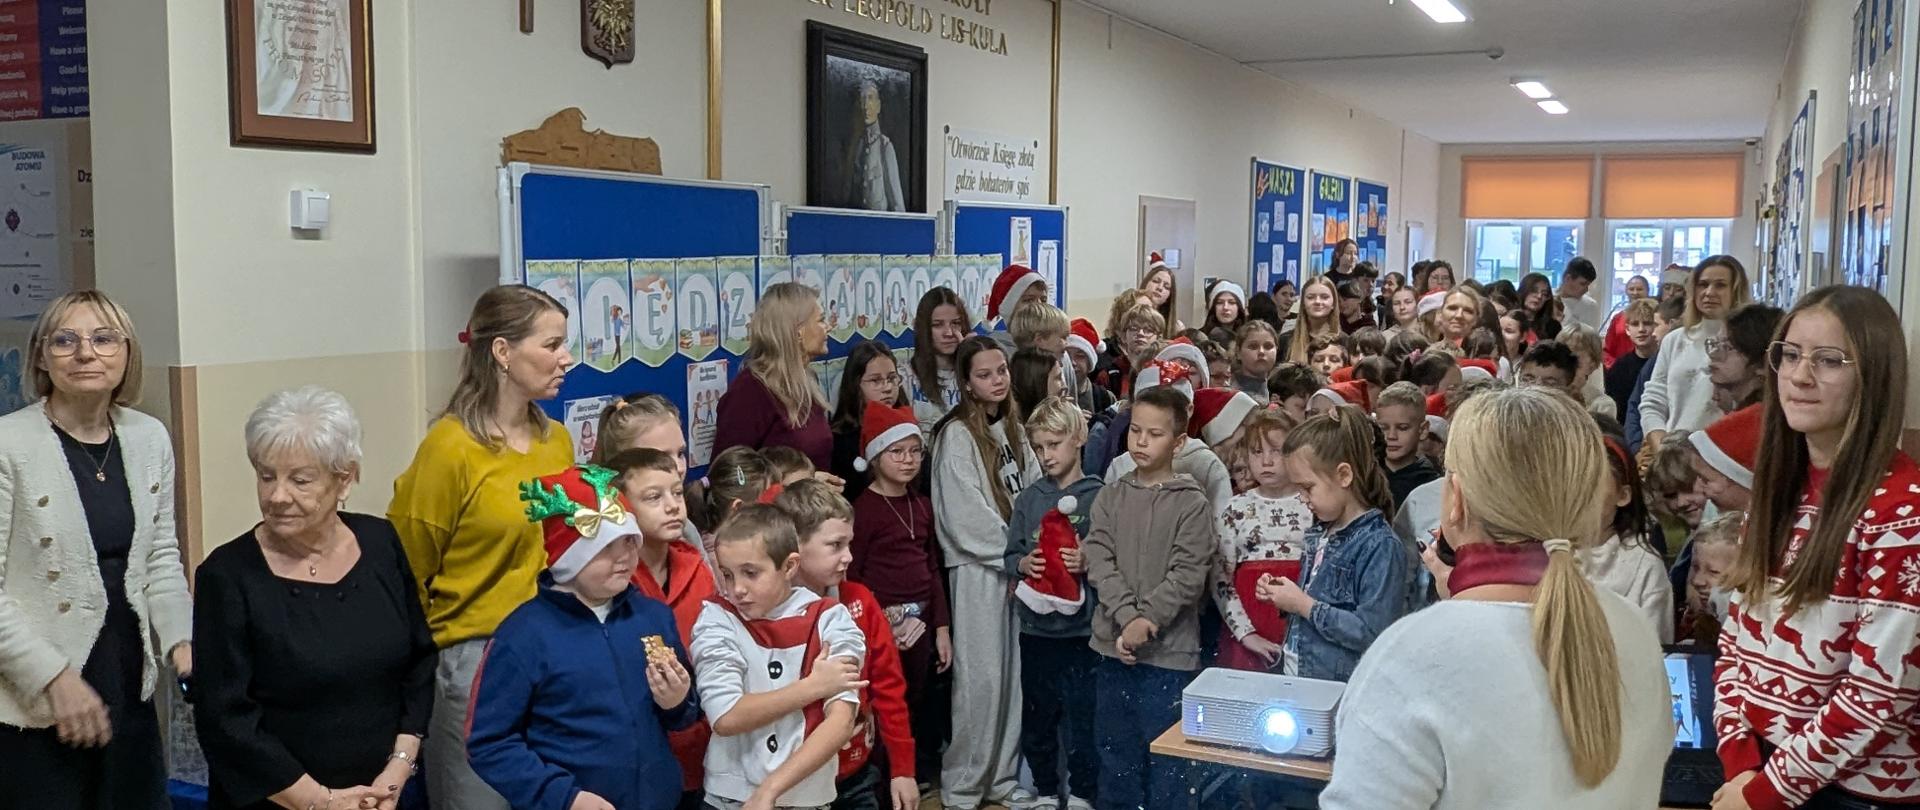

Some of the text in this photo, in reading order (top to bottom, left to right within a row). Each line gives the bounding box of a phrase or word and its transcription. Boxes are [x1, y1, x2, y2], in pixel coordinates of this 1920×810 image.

[940, 13, 1008, 56] LIS-KULA
[12, 151, 45, 161] BUDOWA
[992, 142, 1016, 170] Księgę
[1018, 146, 1035, 171] złotą
[15, 161, 42, 172] ATOMU
[77, 169, 92, 183] Dz
[955, 168, 976, 193] gdzie
[979, 170, 1013, 195] bohaterów
[1268, 167, 1294, 195] NASZA
[80, 226, 95, 238] zie
